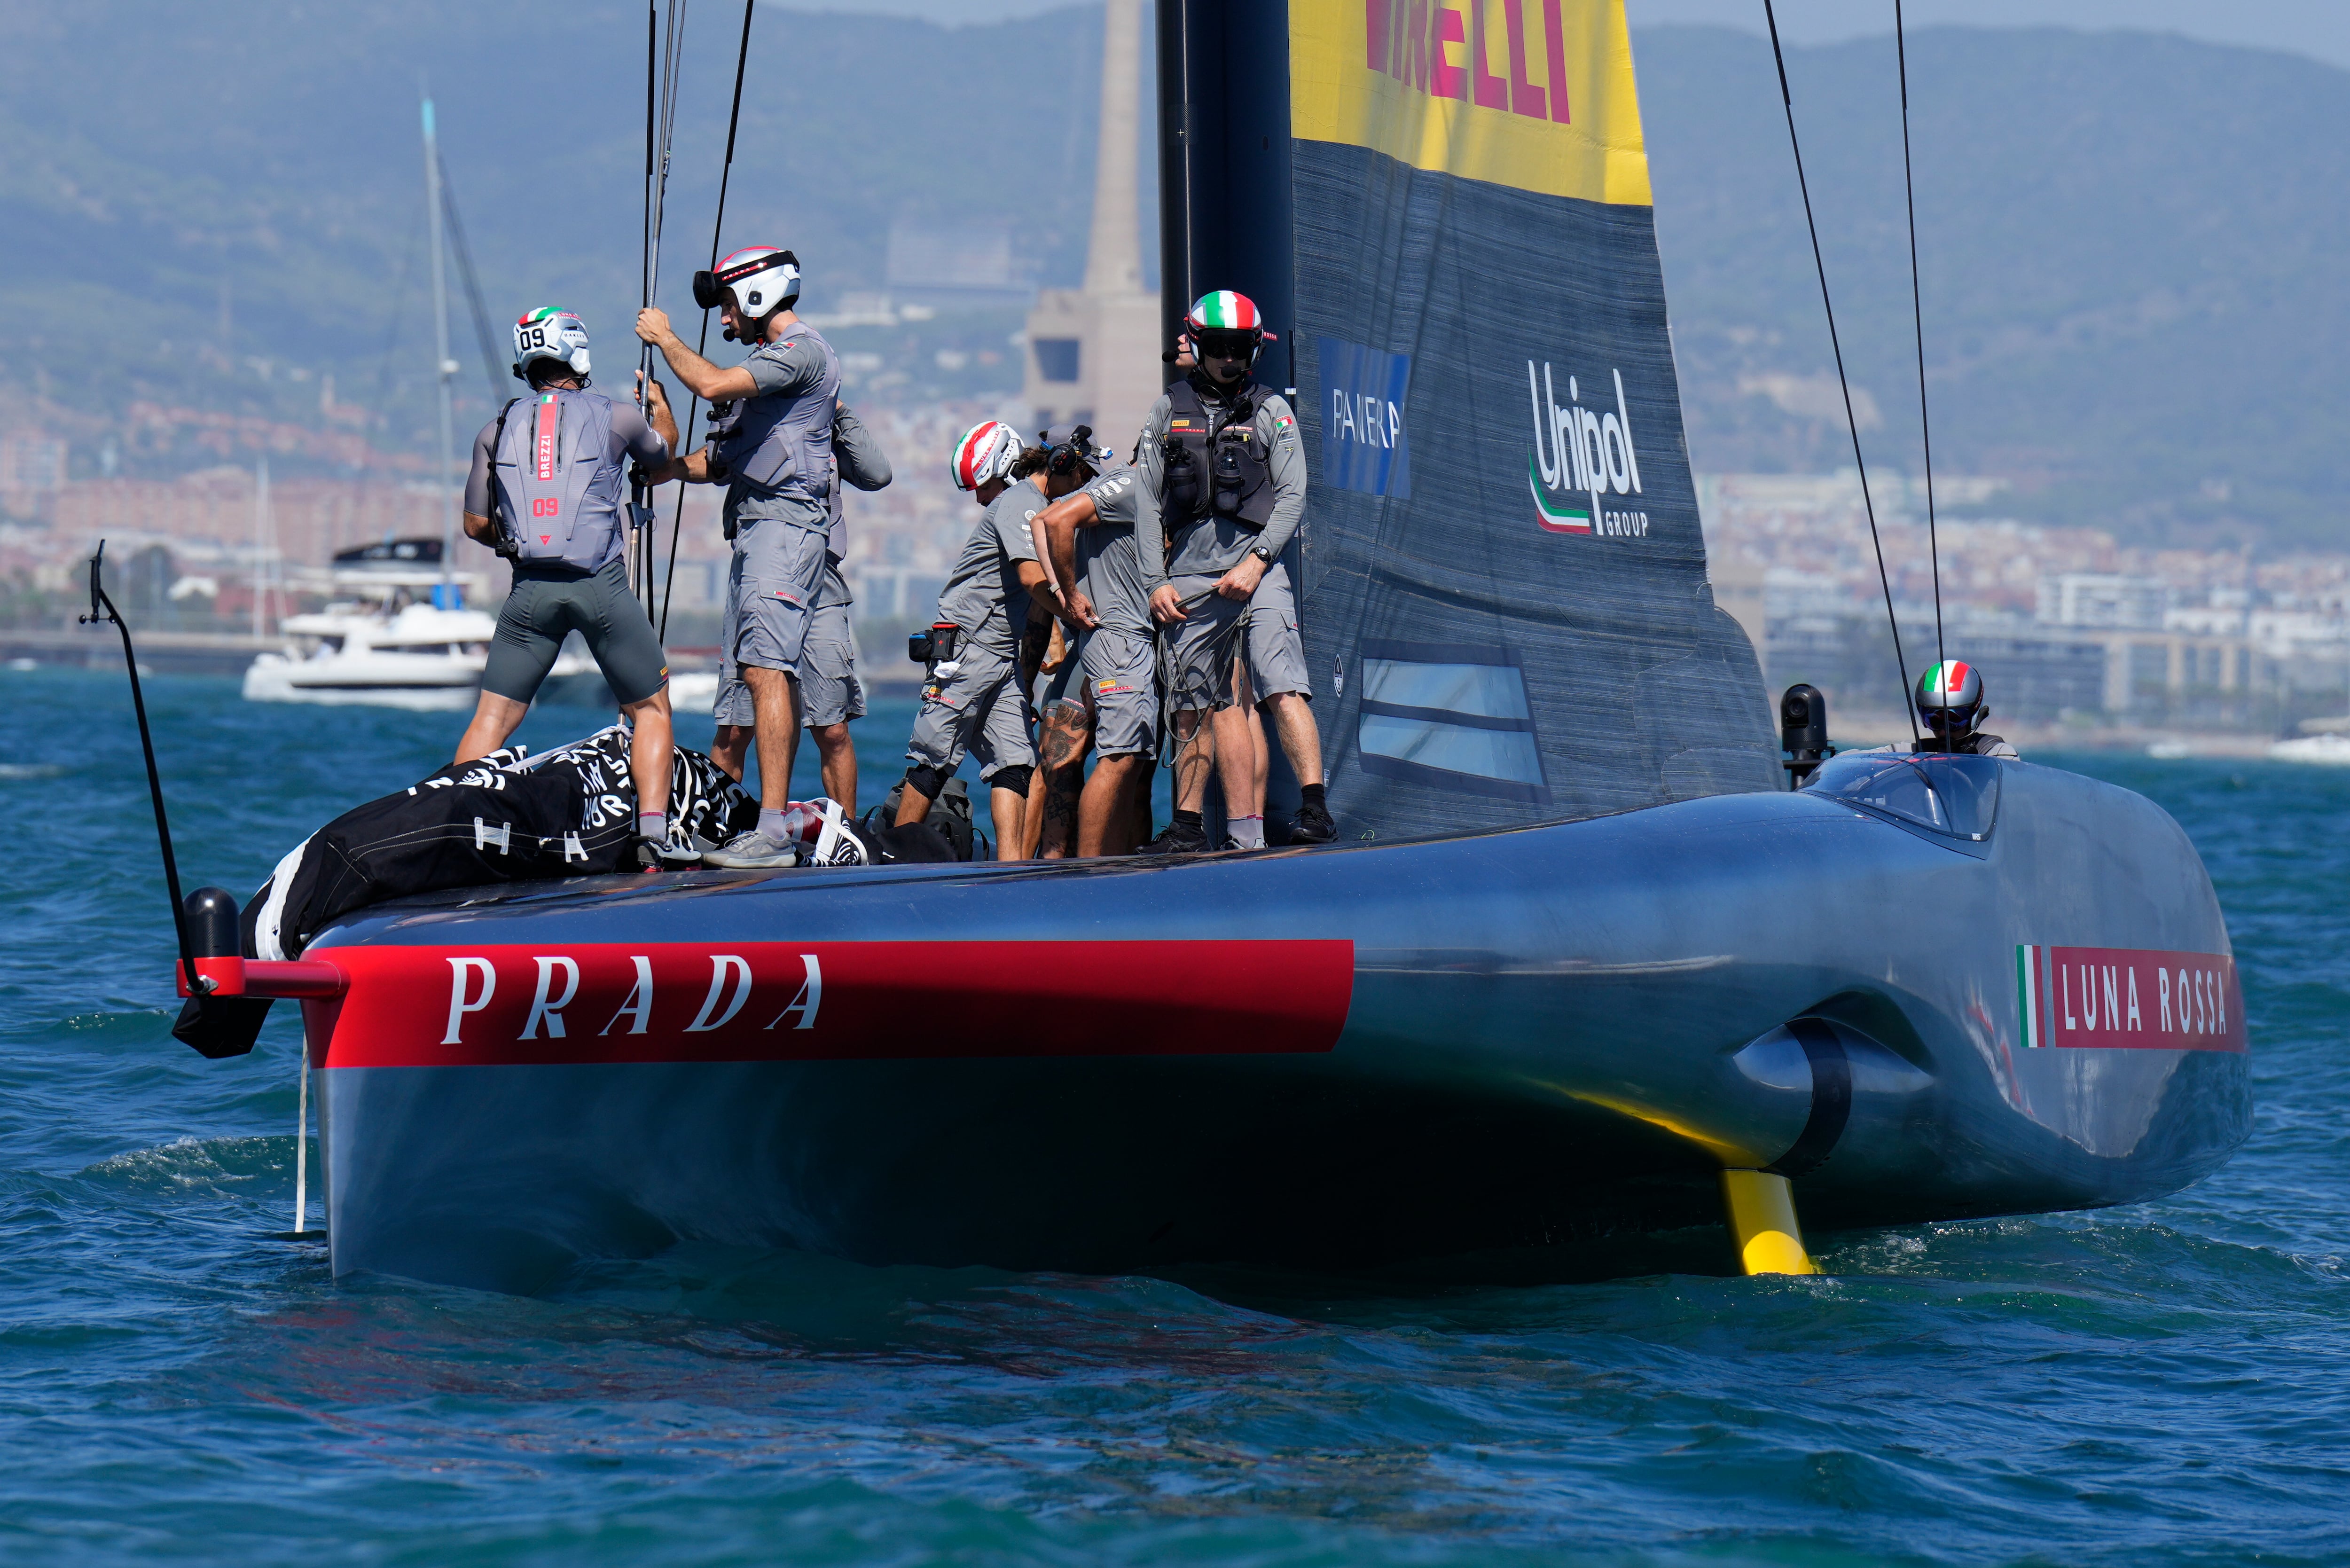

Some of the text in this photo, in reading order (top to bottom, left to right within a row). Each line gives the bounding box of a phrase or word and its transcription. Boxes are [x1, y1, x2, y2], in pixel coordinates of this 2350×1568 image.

[520, 328, 545, 351] 09
[540, 435, 551, 478] BREZZI
[1528, 360, 1641, 535] Unipol
[533, 498, 558, 517] 09
[1605, 511, 1647, 537] GROUP
[440, 954, 822, 1044] PRADA
[2062, 964, 2226, 1035] LUNA ROSSA
